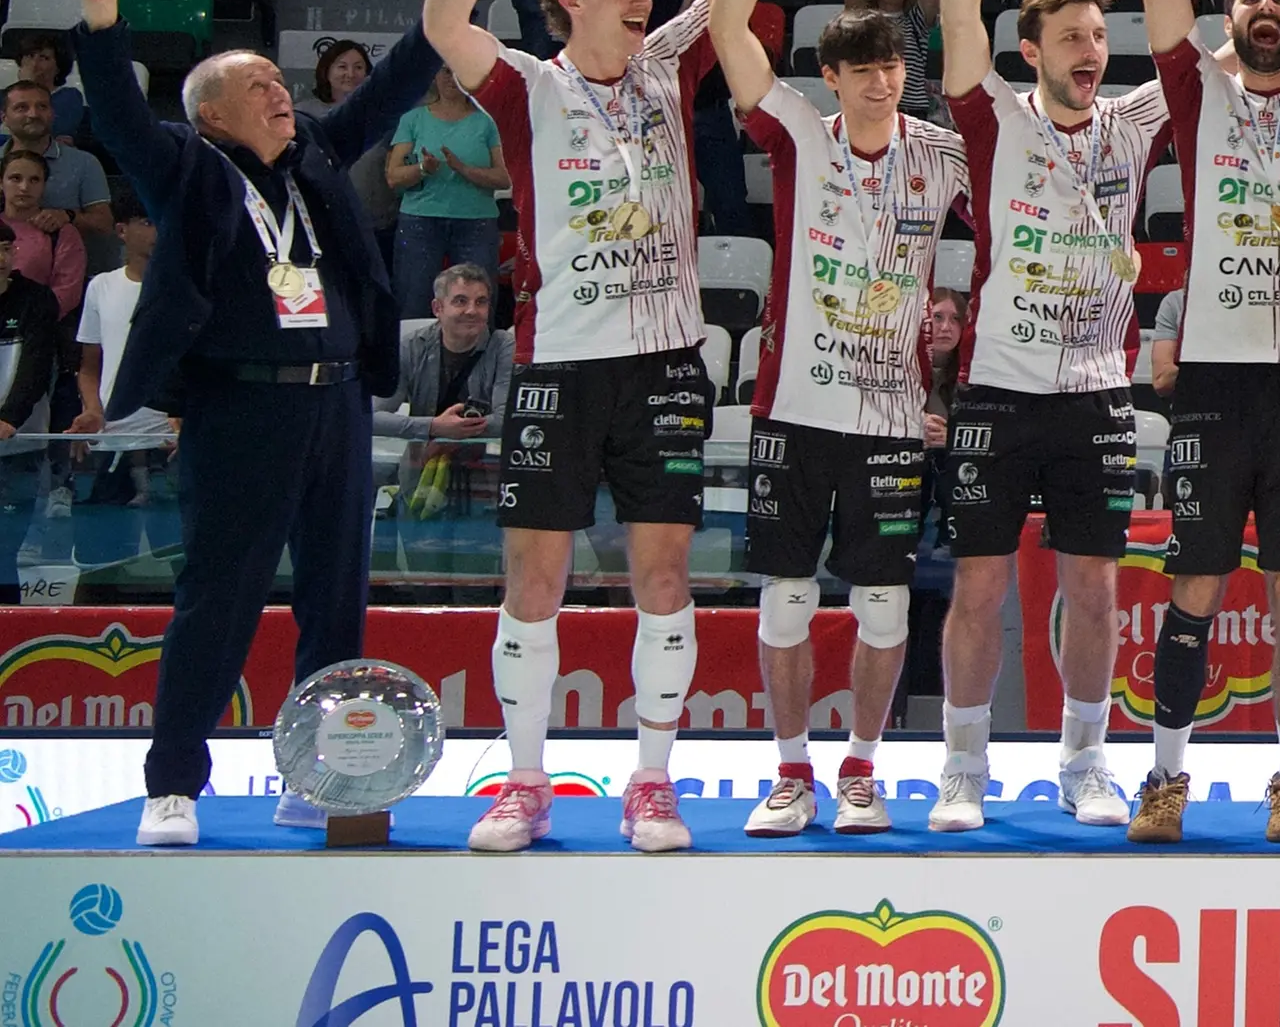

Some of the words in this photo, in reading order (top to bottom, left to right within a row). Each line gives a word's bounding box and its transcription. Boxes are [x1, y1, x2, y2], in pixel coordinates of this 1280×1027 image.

[571, 243, 678, 272] CANALE
[1013, 296, 1104, 322] CANALE
[1248, 290, 1271, 301] CTL
[511, 450, 551, 468] OASI
[952, 485, 988, 501] OASI
[452, 920, 560, 974] LEGA
[783, 963, 848, 1008] Del
[854, 963, 986, 1008] Monte
[449, 980, 695, 1027] PALLAVOLO
